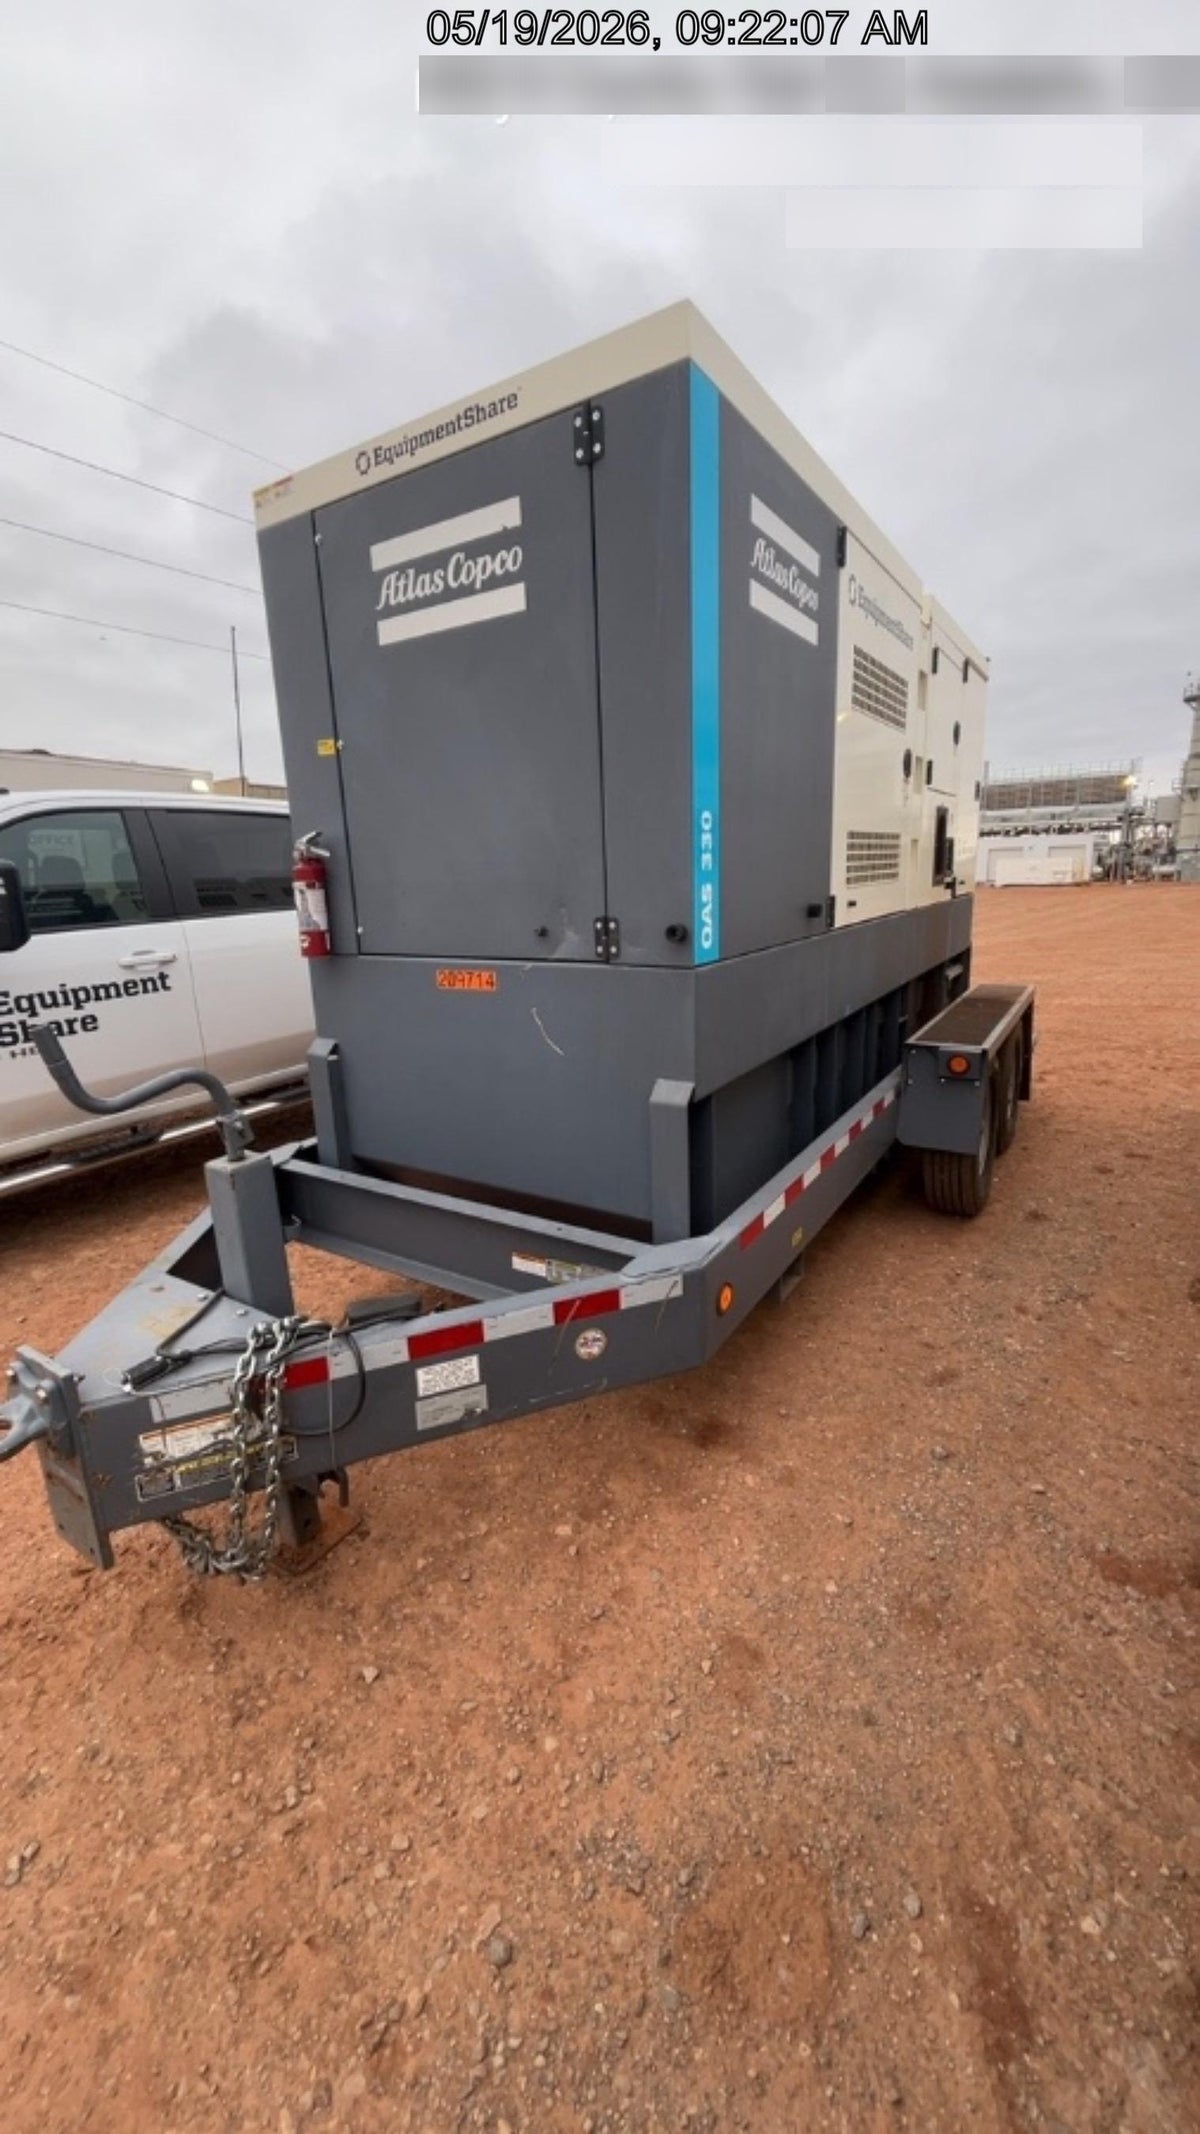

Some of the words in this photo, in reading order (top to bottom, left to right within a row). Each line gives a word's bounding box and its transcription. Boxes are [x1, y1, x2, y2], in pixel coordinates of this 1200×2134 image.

[373, 391, 519, 467] EquipmentShare
[376, 567, 444, 610] Atlas
[448, 545, 523, 589] Copco
[701, 810, 713, 871] 330
[701, 883, 713, 949] QAS
[0, 971, 172, 1018] Equipment
